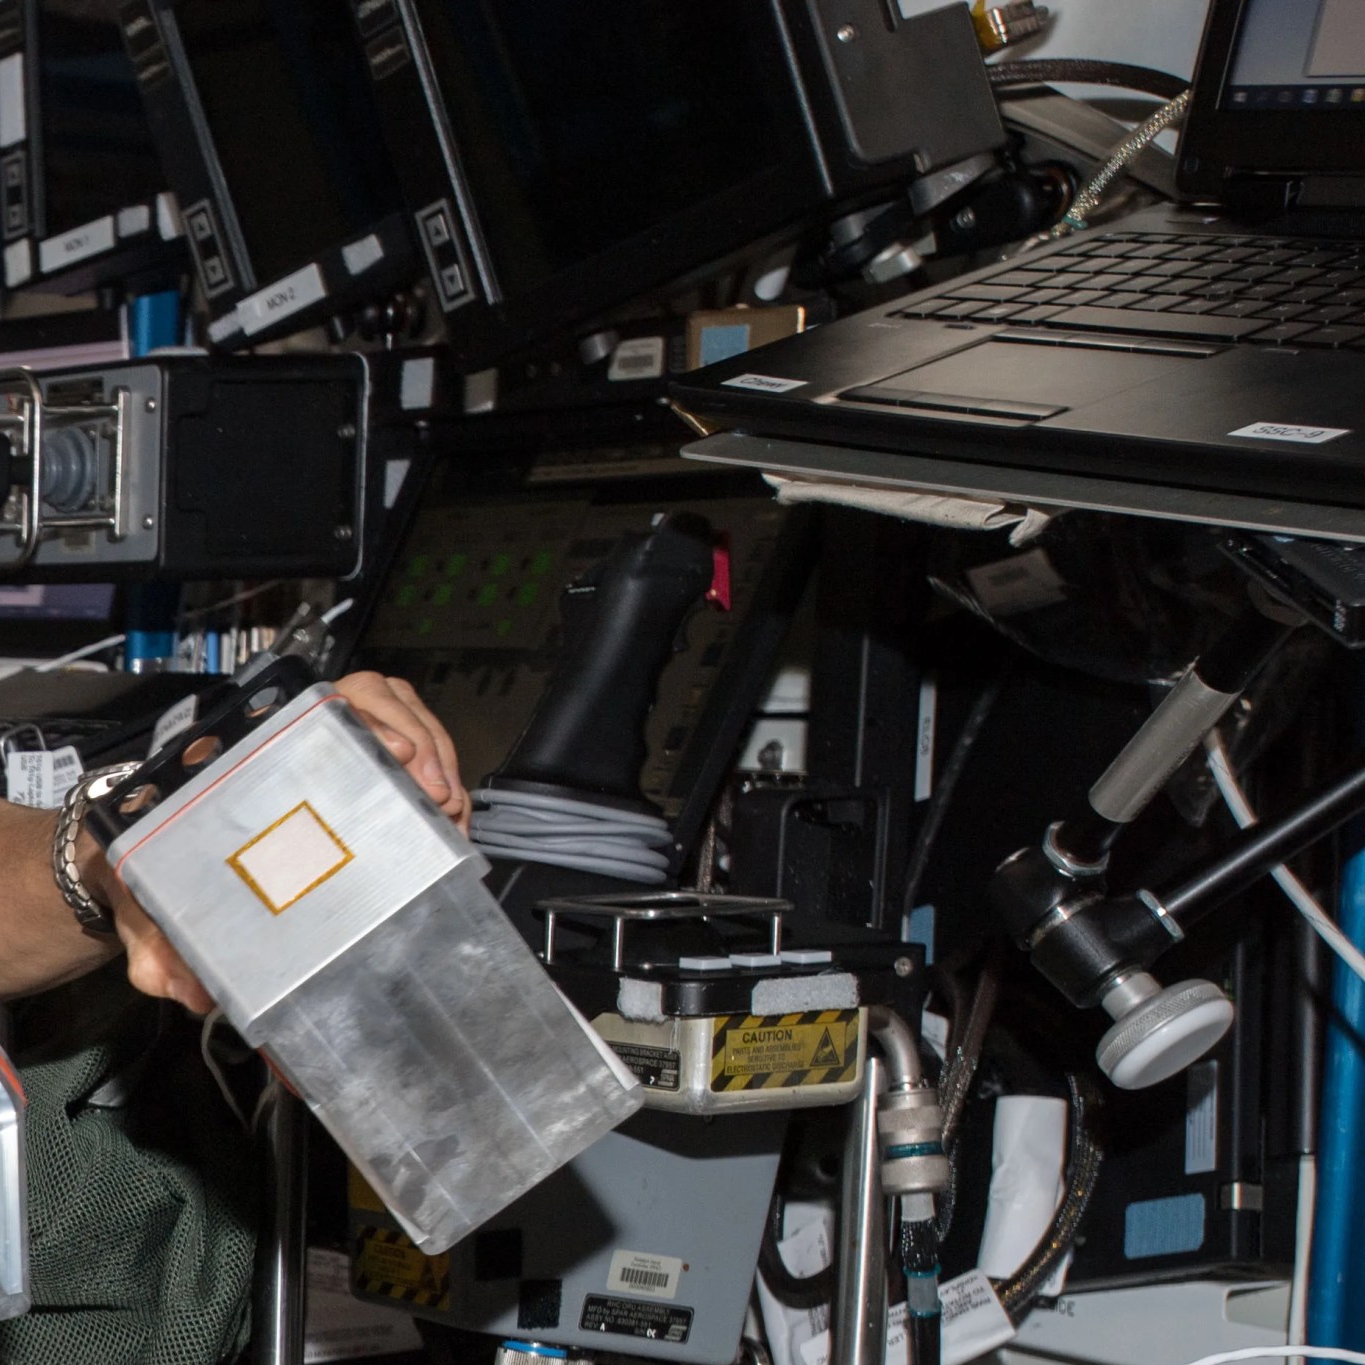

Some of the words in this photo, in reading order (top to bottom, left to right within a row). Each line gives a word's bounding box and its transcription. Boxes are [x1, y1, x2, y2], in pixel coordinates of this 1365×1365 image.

[742, 1029, 792, 1043] CAUTION
[752, 1045, 764, 1054] AND
[622, 1056, 658, 1067] AEROSPACE
[726, 1063, 771, 1073] ELECTROSTATIC
[629, 1311, 667, 1322] AEROSPACE
